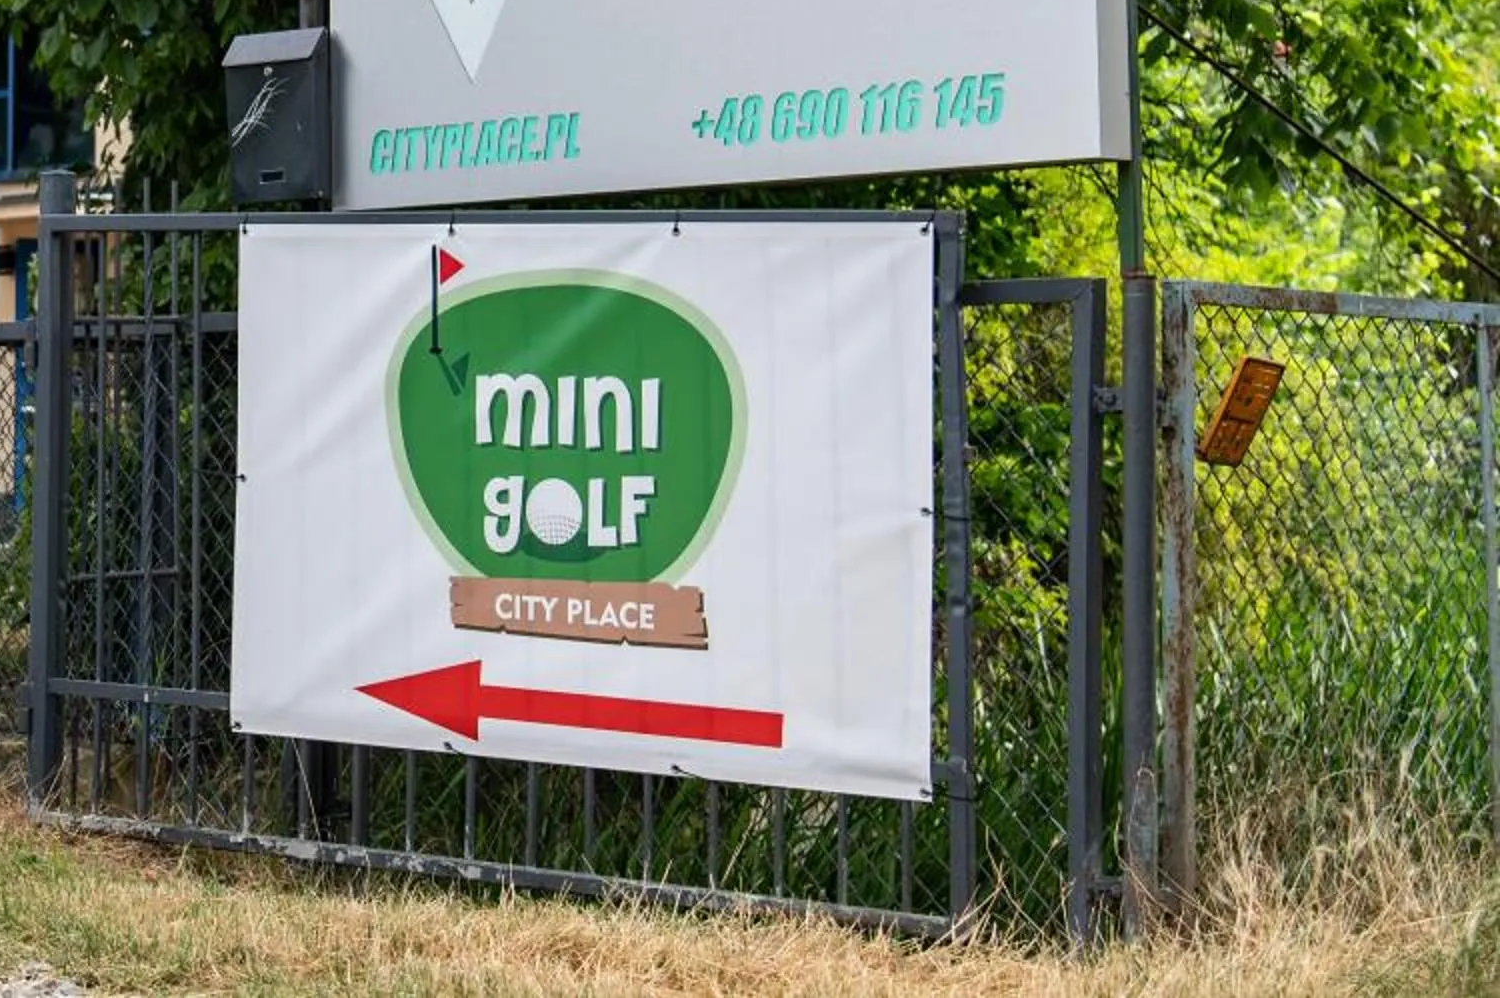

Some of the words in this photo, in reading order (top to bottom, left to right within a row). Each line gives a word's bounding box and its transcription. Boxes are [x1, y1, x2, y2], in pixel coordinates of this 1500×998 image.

[692, 95, 764, 147] +48
[771, 88, 850, 143] 690
[859, 79, 924, 136] 116
[934, 72, 1007, 129] 145
[370, 112, 581, 175] CITYPLACE.PL
[494, 593, 559, 621] CITY
[566, 598, 655, 630] PLACE
